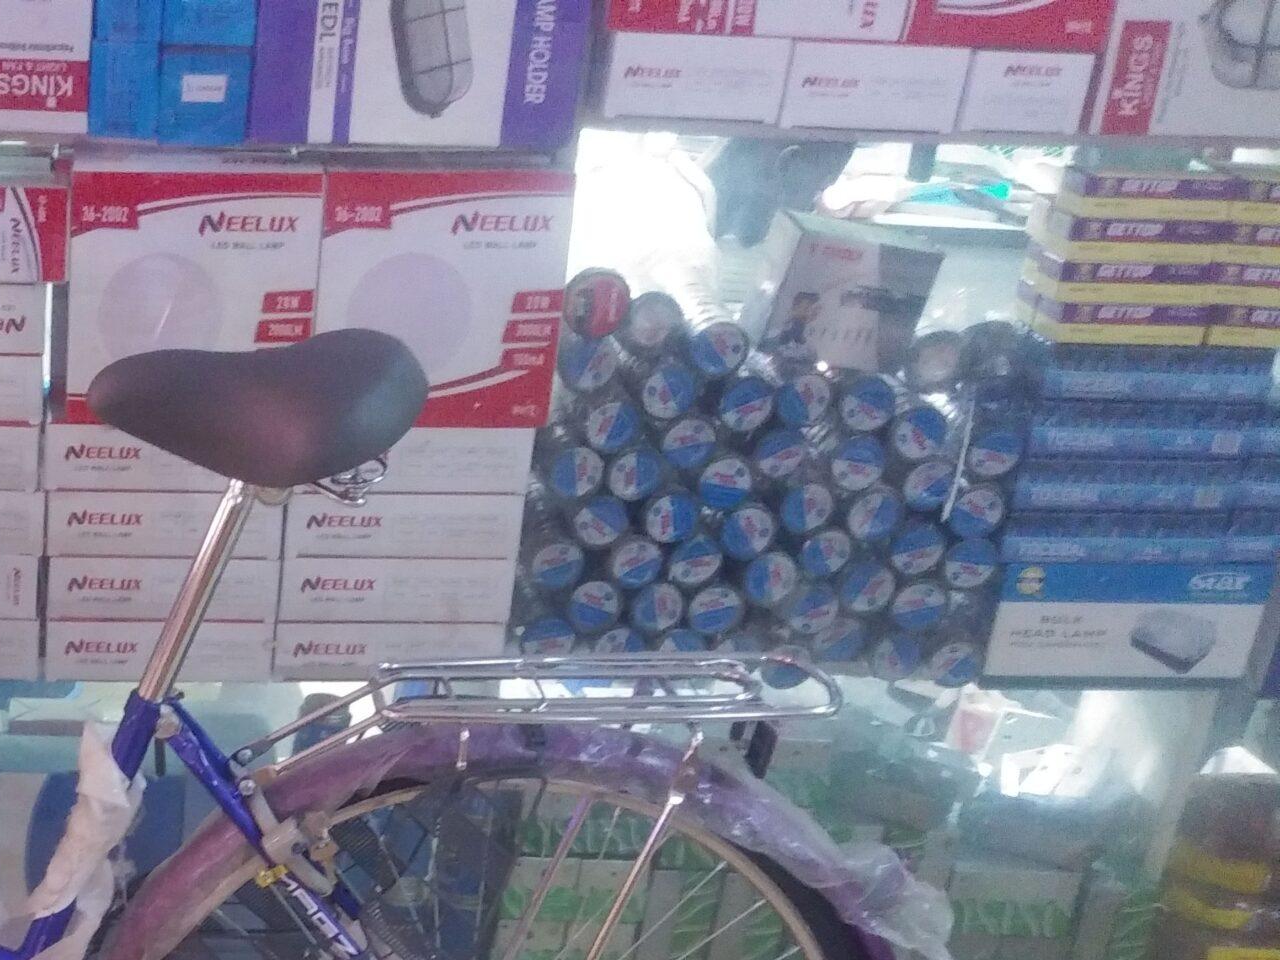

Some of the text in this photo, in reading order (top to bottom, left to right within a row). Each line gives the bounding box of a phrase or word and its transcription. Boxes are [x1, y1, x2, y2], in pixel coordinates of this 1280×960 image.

[523, 36, 553, 104] HOLDER
[1118, 34, 1154, 117] KINGS
[199, 211, 300, 237] NEELUX
[451, 210, 554, 235] NEELUX
[65, 444, 142, 461] NEELUX
[68, 509, 143, 528] NEELUX
[306, 512, 383, 530] NEELUX
[67, 575, 142, 592] NEELUX
[300, 576, 377, 593] NEELUX
[64, 639, 139, 656] NEELUX
[293, 640, 368, 659] NEELUX
